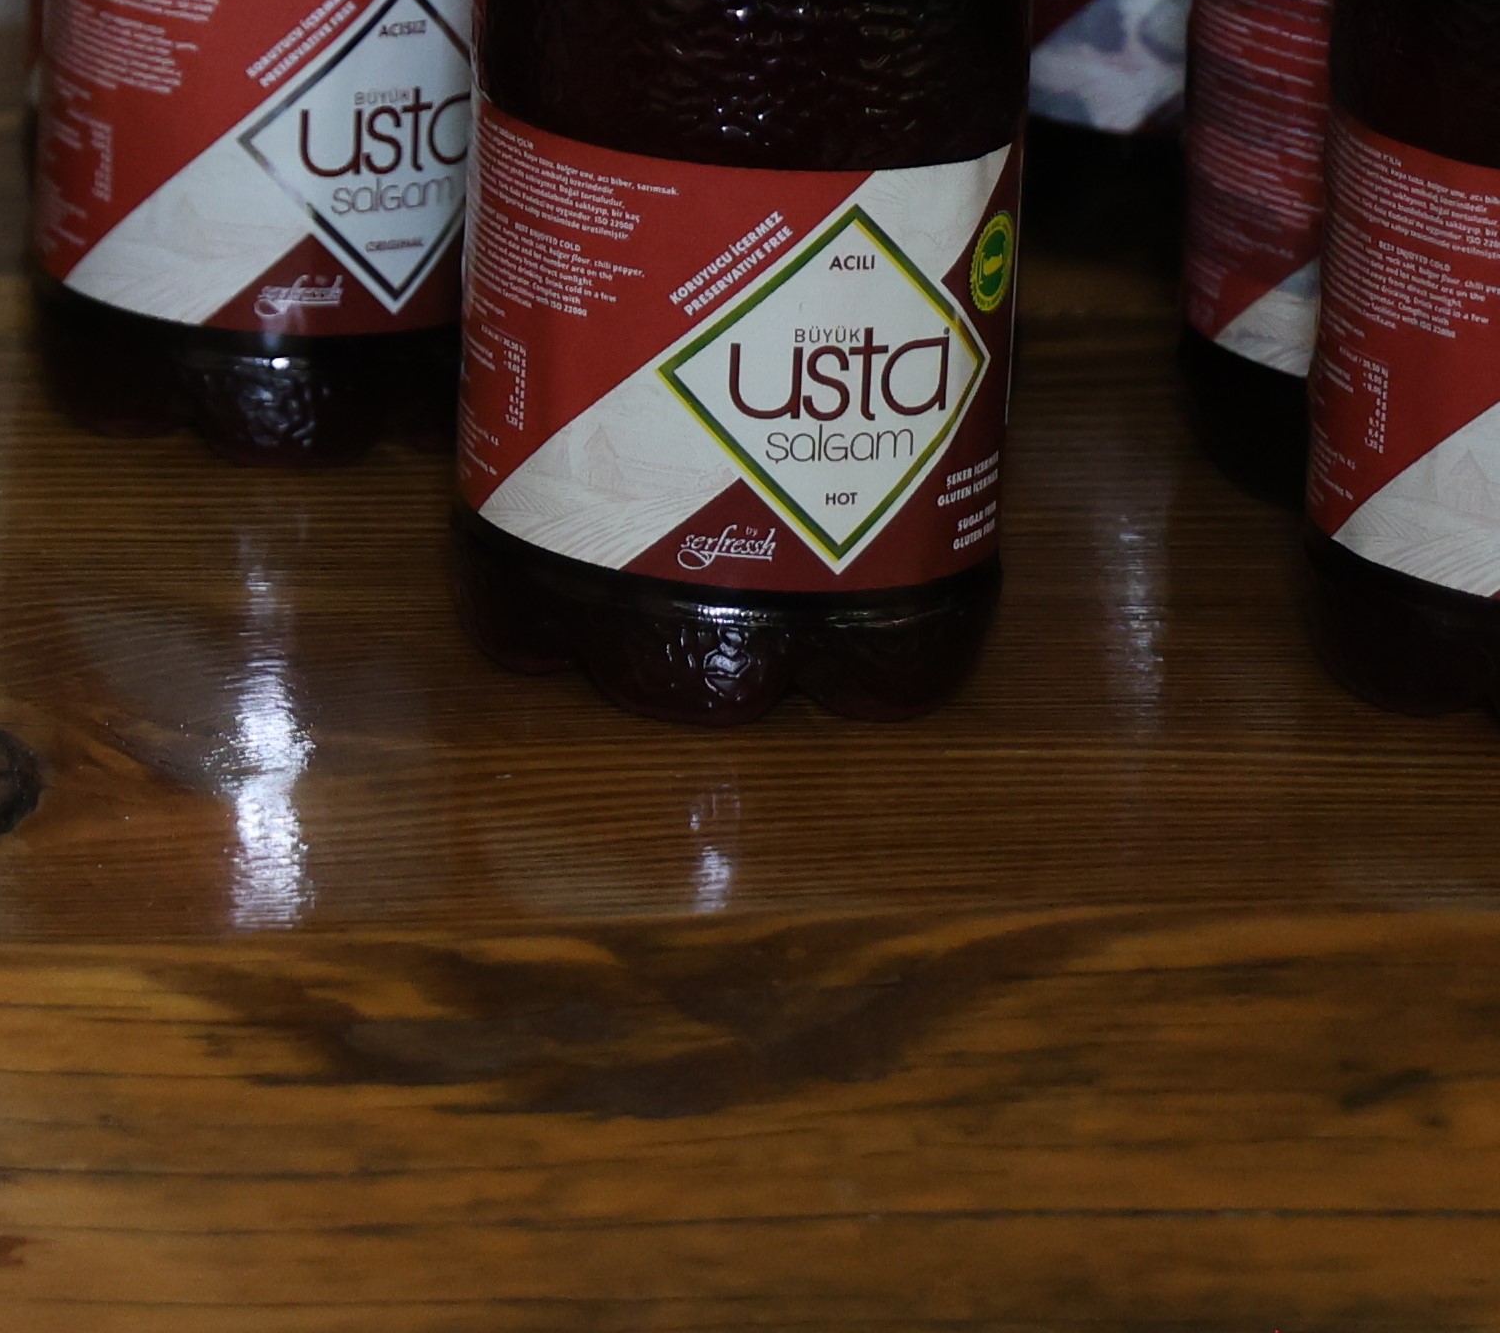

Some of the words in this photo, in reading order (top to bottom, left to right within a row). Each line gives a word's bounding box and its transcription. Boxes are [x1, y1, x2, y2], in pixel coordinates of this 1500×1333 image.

[669, 247, 734, 305] KORUYUCU
[726, 210, 785, 258] İÇERMEZ
[829, 255, 875, 271] ACILI
[683, 250, 760, 315] PRESERVATIVE
[753, 226, 793, 260] FREE
[794, 328, 860, 344] BÜYÜK
[729, 328, 953, 421] usta
[826, 492, 856, 505] HOT
[745, 525, 758, 538] by
